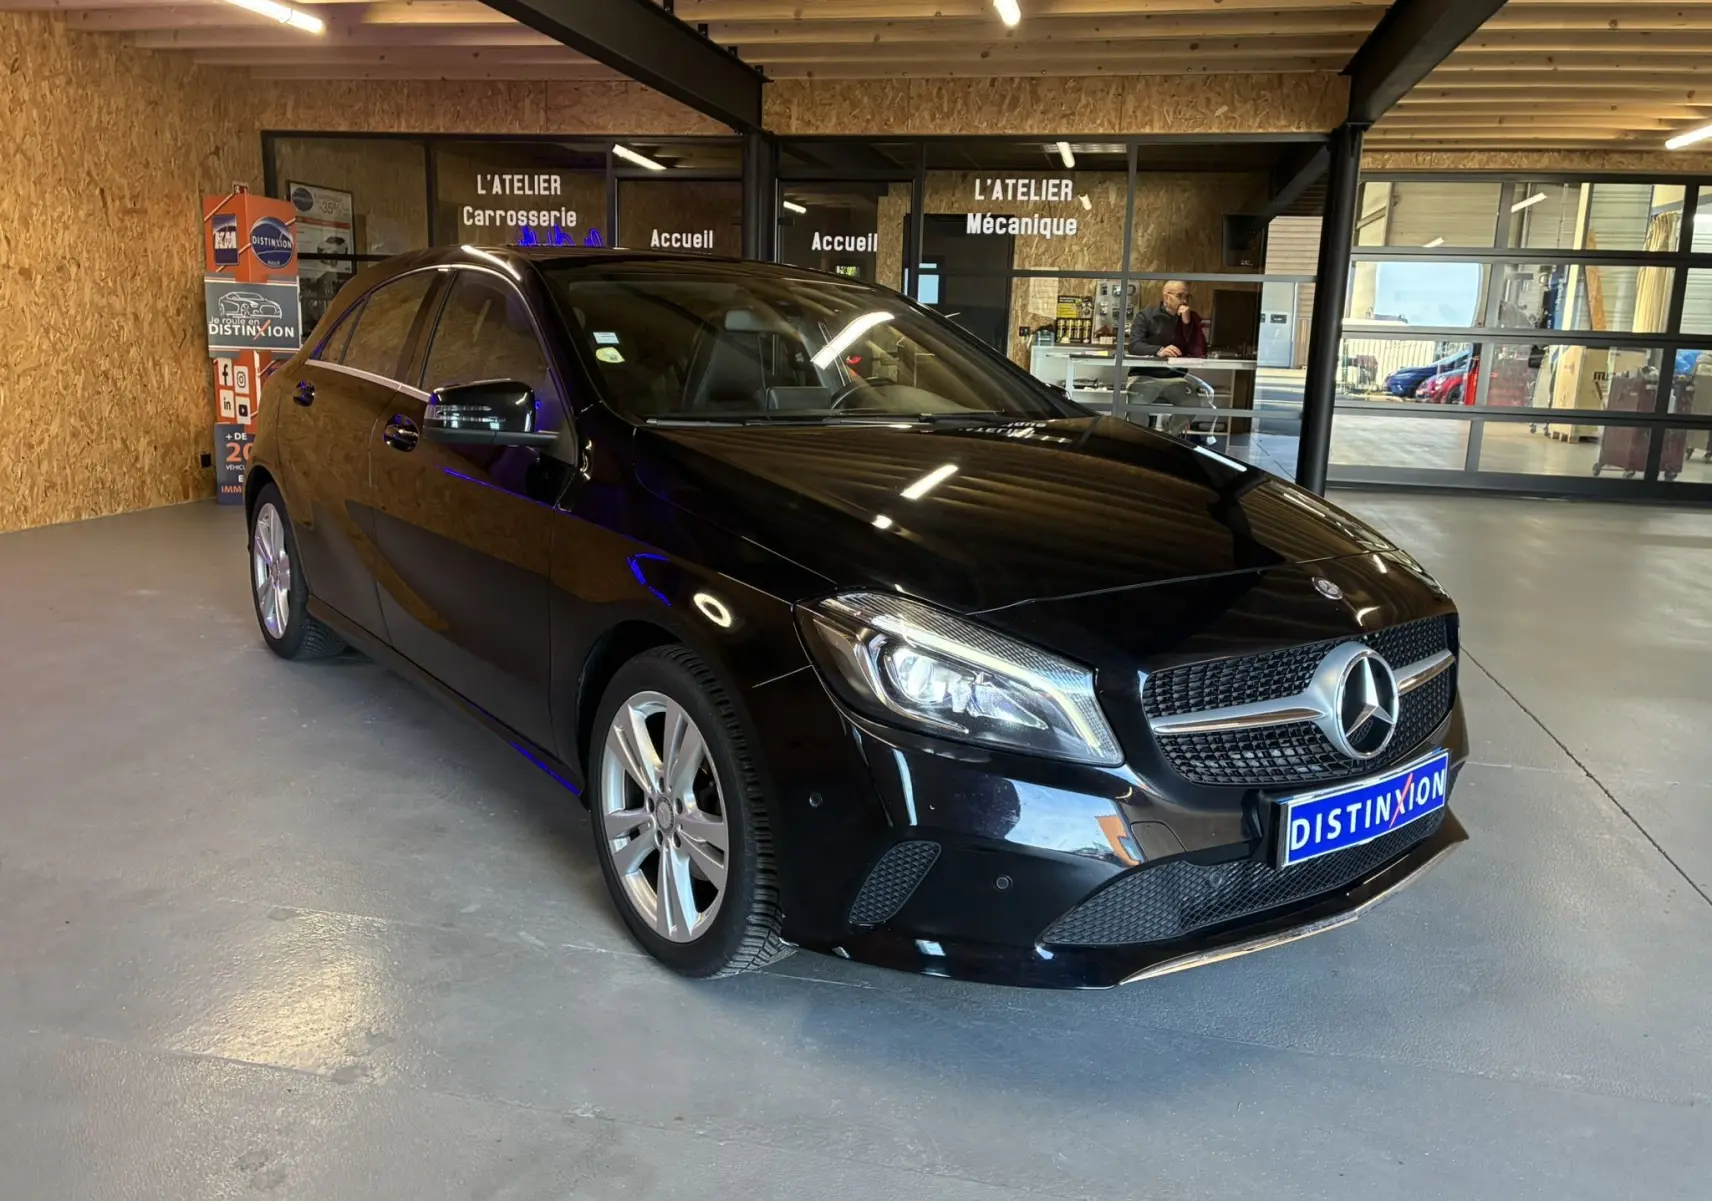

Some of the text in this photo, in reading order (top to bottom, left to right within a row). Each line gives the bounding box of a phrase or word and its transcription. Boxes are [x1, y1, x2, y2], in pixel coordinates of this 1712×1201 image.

[477, 175, 561, 196] L'ATELIER
[974, 179, 1073, 201] L'ATELIER
[463, 205, 578, 229] Carrosserie
[966, 212, 1078, 239] Mécanique
[251, 235, 292, 249] DISTINXION
[650, 229, 714, 250] Accueil
[811, 232, 878, 252] Accueil
[208, 317, 220, 325] Je
[222, 317, 246, 325] roule
[208, 322, 295, 339] DISTINXION
[234, 432, 248, 440] DE
[221, 485, 242, 493] IMM
[238, 475, 244, 483] E
[1291, 769, 1446, 851] DISTINXION
